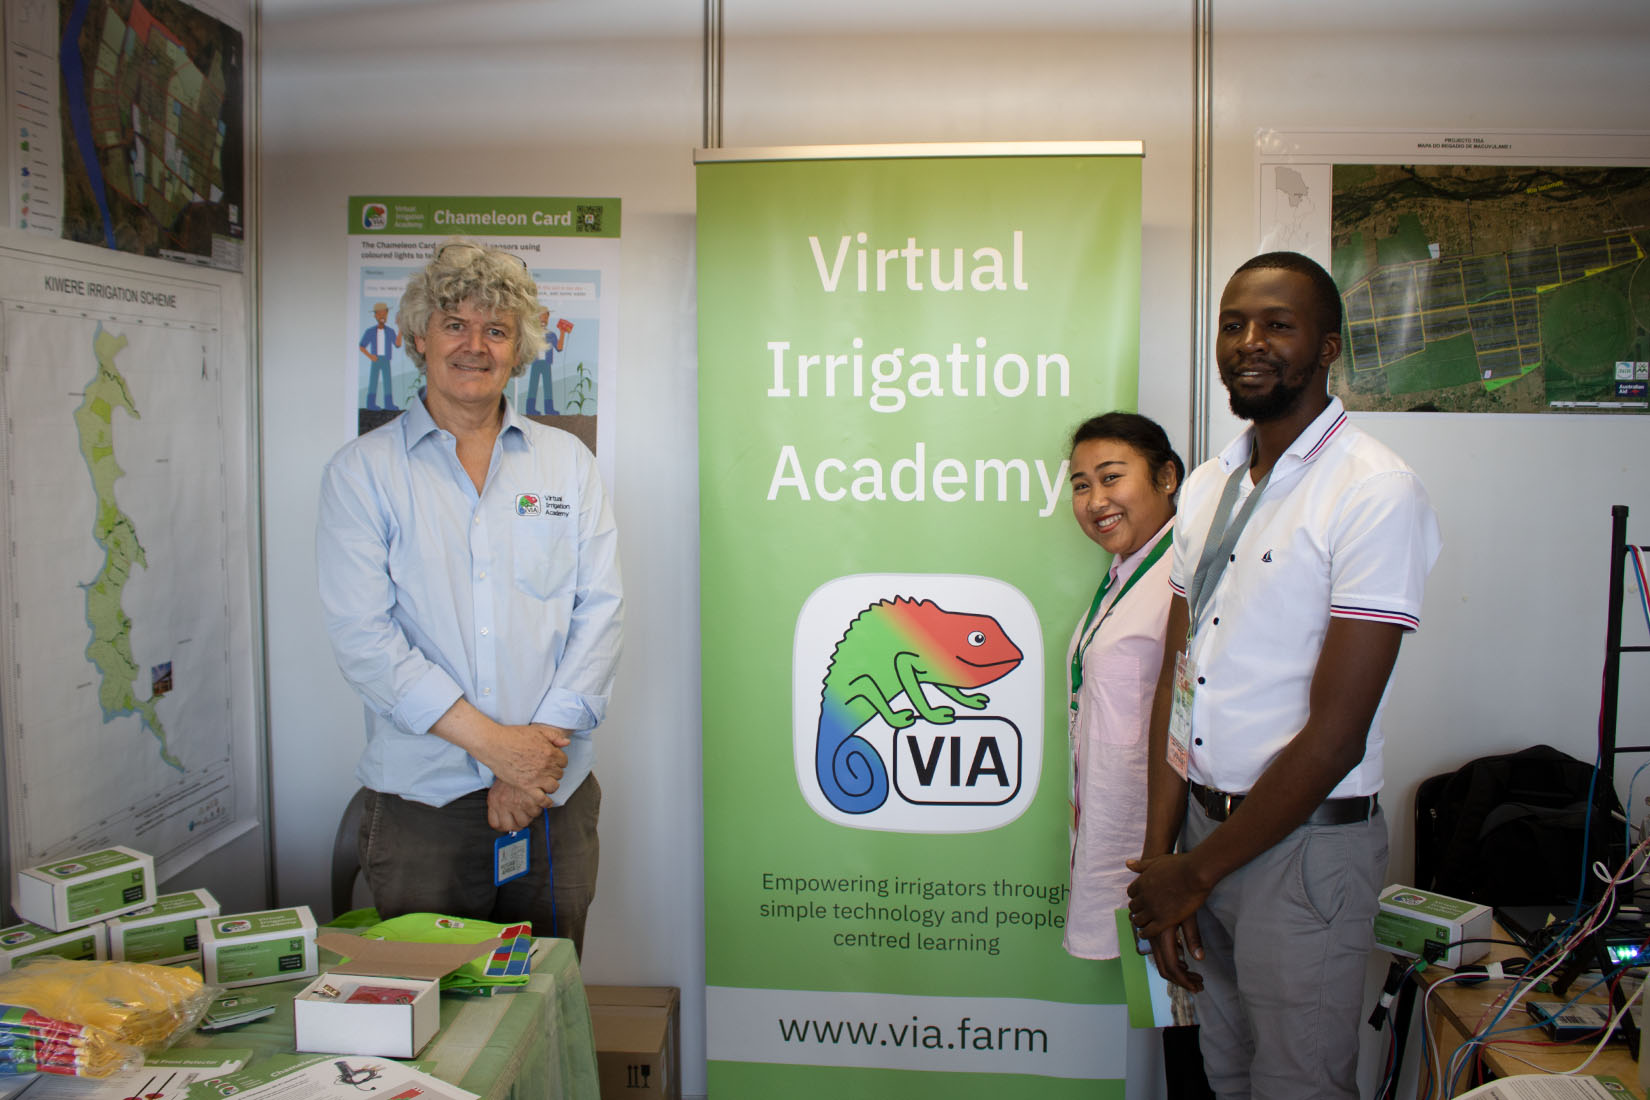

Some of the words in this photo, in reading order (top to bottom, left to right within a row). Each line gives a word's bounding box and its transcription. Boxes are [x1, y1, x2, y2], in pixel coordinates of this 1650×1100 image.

[433, 210, 528, 226] Chameleon
[531, 210, 572, 227] Card
[361, 250, 393, 259] coloured
[394, 250, 414, 261] lights
[415, 251, 423, 259] to
[362, 241, 375, 249] The
[376, 241, 417, 249] Chameleon
[418, 241, 437, 249] Card
[519, 243, 541, 252] using
[808, 230, 1029, 292] Virtual
[44, 275, 85, 296] KIWERE
[87, 282, 138, 303] IRRIGATION
[140, 290, 177, 309] SCHEME
[766, 336, 1071, 413] Irrigation
[766, 442, 1071, 517] Academy
[545, 509, 570, 517] Academy
[906, 735, 1010, 787] VIA
[762, 873, 889, 897] Empowering
[895, 876, 987, 900] irrigators
[993, 879, 1070, 905] through
[759, 901, 827, 922] simple
[832, 903, 945, 927] technology
[950, 906, 989, 924] and
[995, 909, 1066, 930] people
[833, 931, 911, 949] centred
[917, 933, 1000, 956] learning
[778, 1015, 1049, 1053] www.via.farm
